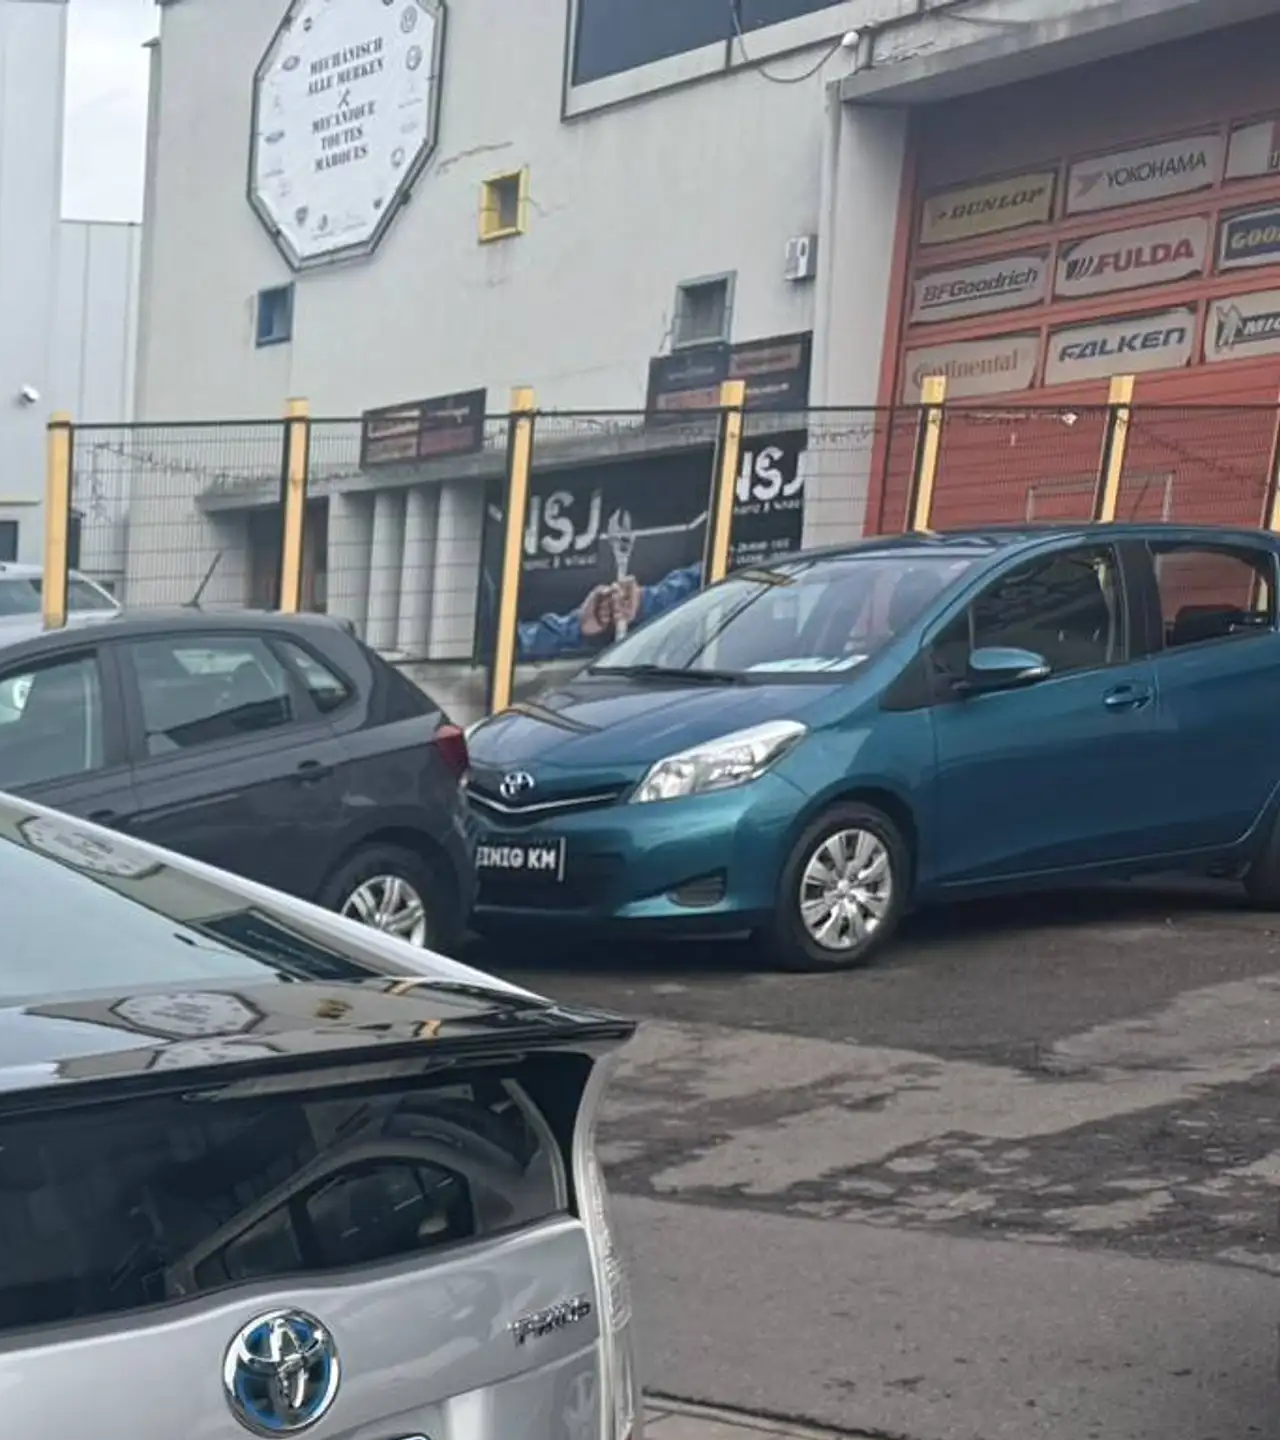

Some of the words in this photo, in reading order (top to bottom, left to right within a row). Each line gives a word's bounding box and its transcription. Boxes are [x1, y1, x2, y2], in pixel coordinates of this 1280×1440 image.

[310, 36, 384, 76] MECHANISCH
[307, 75, 333, 96] ALLE
[338, 57, 385, 88] MERKEN
[321, 124, 364, 151] TOUTES
[314, 144, 369, 172] MARQUES
[1105, 150, 1207, 188] YOKOHAMA
[950, 186, 1045, 219] DUNLOP
[1231, 224, 1280, 250] GOO
[1090, 238, 1196, 277] FULDA
[922, 267, 1039, 301] BFGoodrich
[1059, 326, 1187, 362] FALKEN
[912, 348, 1019, 390] Cntinental
[527, 847, 556, 869] KM
